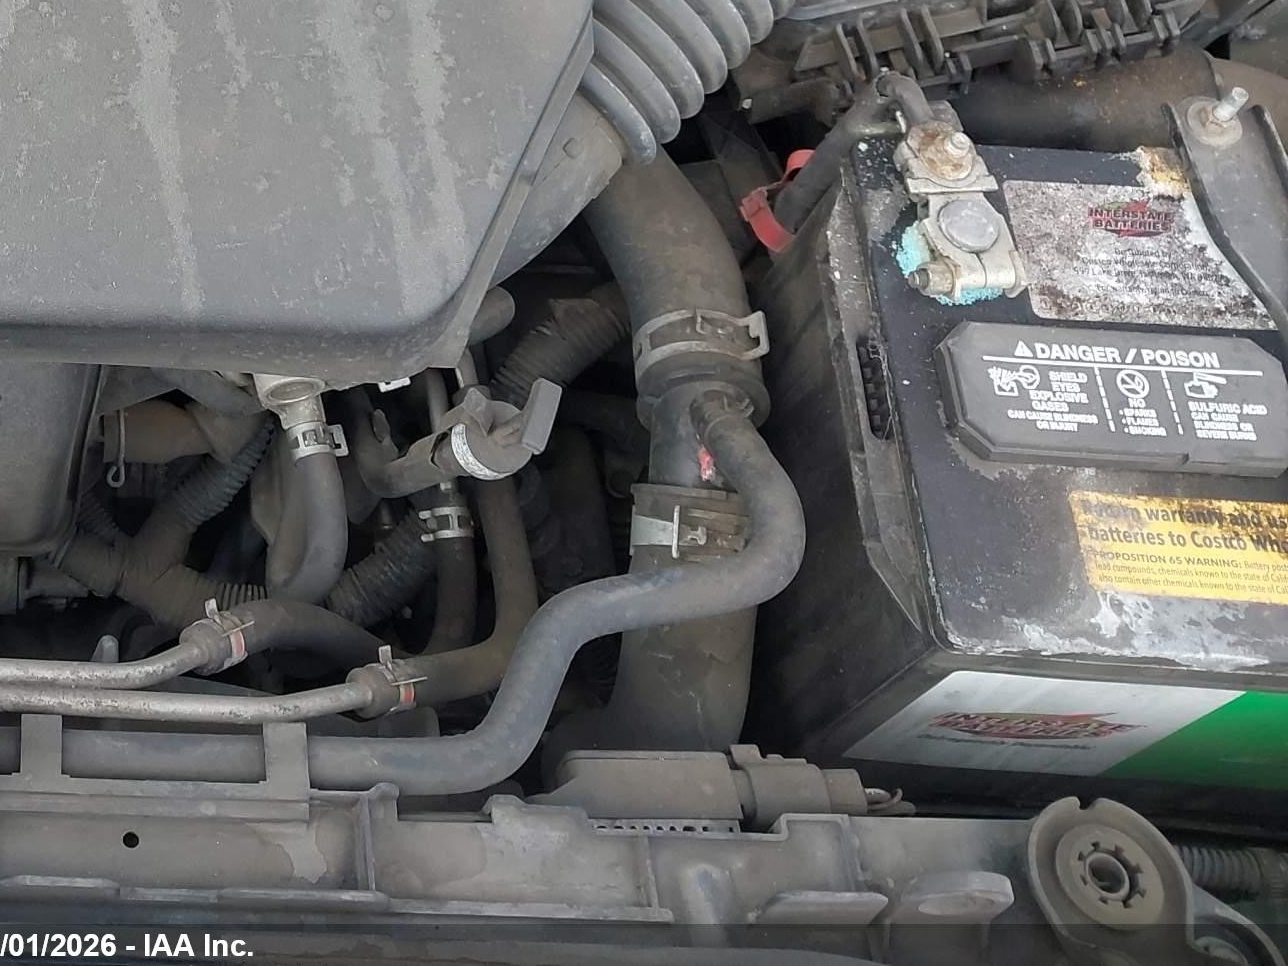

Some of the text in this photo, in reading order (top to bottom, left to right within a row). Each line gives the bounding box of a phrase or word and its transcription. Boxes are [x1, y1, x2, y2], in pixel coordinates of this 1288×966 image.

[1088, 207, 1174, 221] INTERSTATE
[1093, 219, 1172, 231] BATTERIES
[1035, 343, 1220, 369] DANGER / POISON
[1049, 370, 1087, 383] SHIELD
[1052, 382, 1081, 392] EYES
[1029, 389, 1089, 403] EXPLOSIVE
[1127, 397, 1146, 408] NO
[1031, 400, 1070, 412] GASES
[1187, 400, 1268, 415] SULFURIC ACID
[1007, 409, 1026, 419] CAN
[1026, 410, 1053, 421] CAUSE
[1191, 411, 1240, 423] CAN CAUSE
[1144, 506, 1225, 529] warranty
[1089, 525, 1165, 546] batteries
[1168, 531, 1187, 547] to
[1190, 530, 1248, 551] Costco
[1092, 549, 1167, 564] PROPOSITION
[1169, 556, 1183, 565] 65
[1184, 556, 1242, 569] WARNING:
